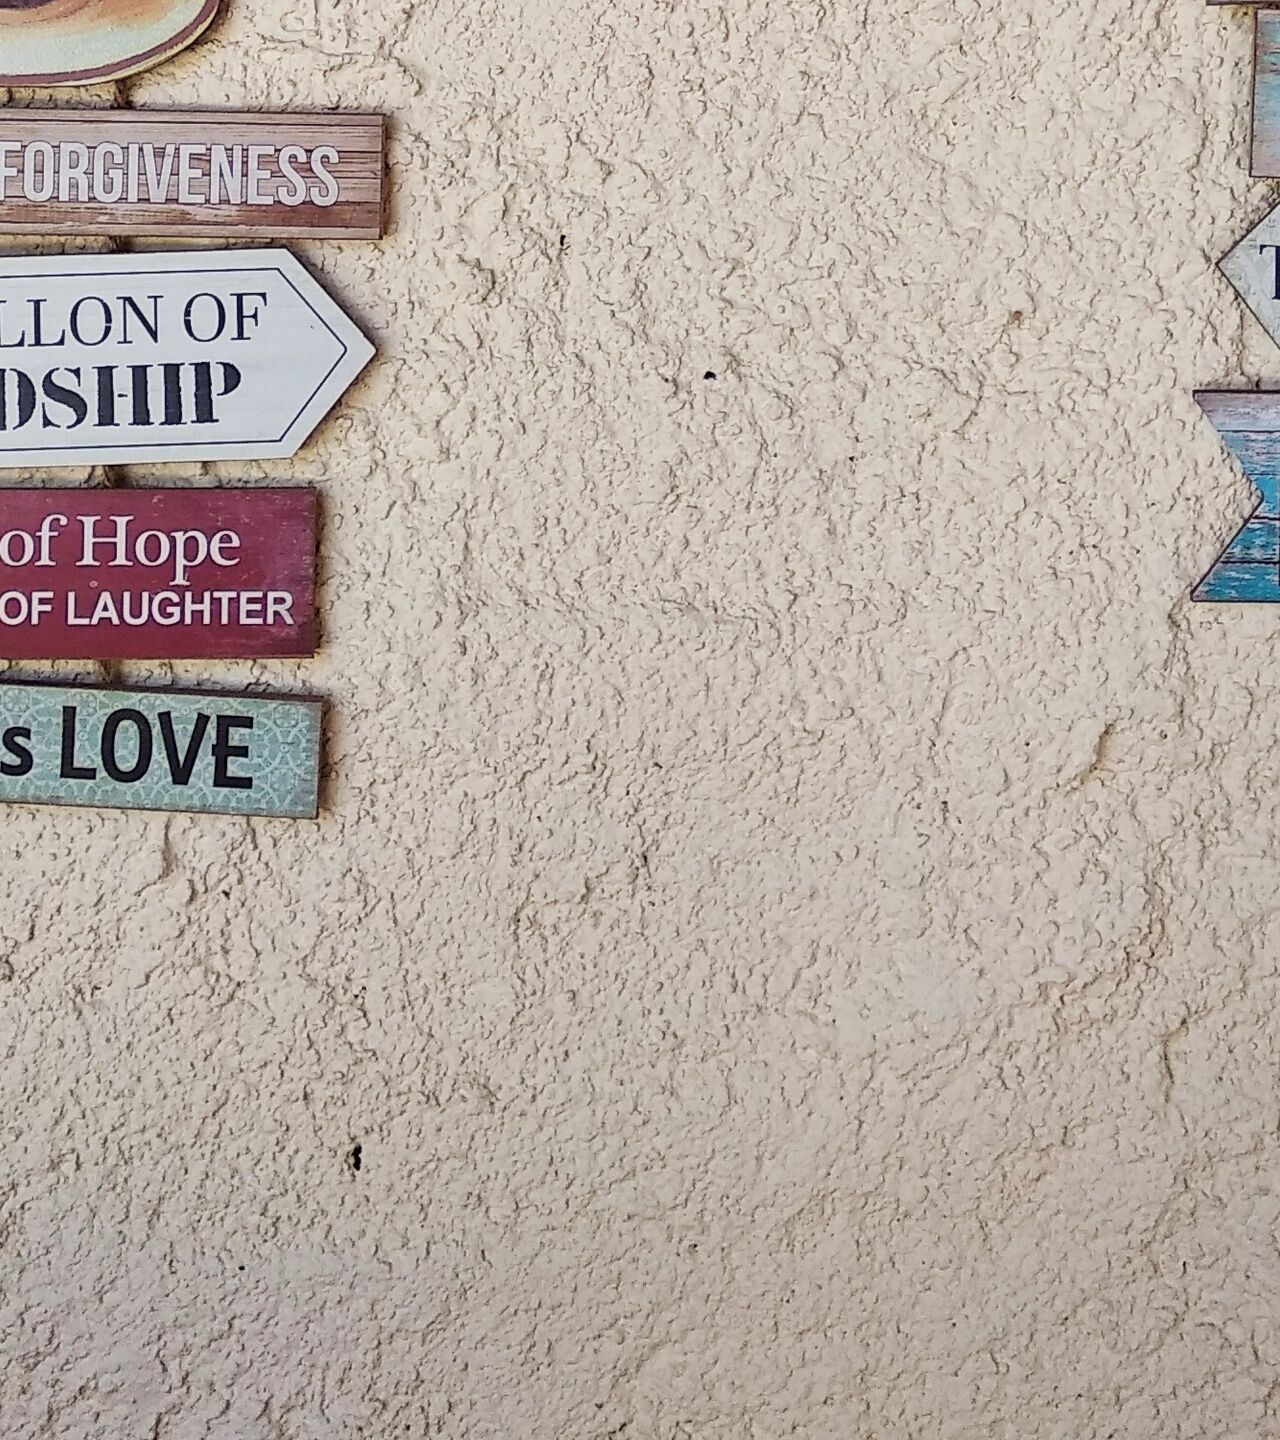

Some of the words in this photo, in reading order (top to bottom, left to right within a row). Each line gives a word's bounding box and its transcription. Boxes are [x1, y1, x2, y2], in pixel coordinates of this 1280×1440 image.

[183, 291, 268, 343] OF
[0, 513, 68, 567] of
[75, 514, 241, 586] Hope
[67, 589, 295, 626] LAUGHTER
[60, 704, 254, 790] LOVE
